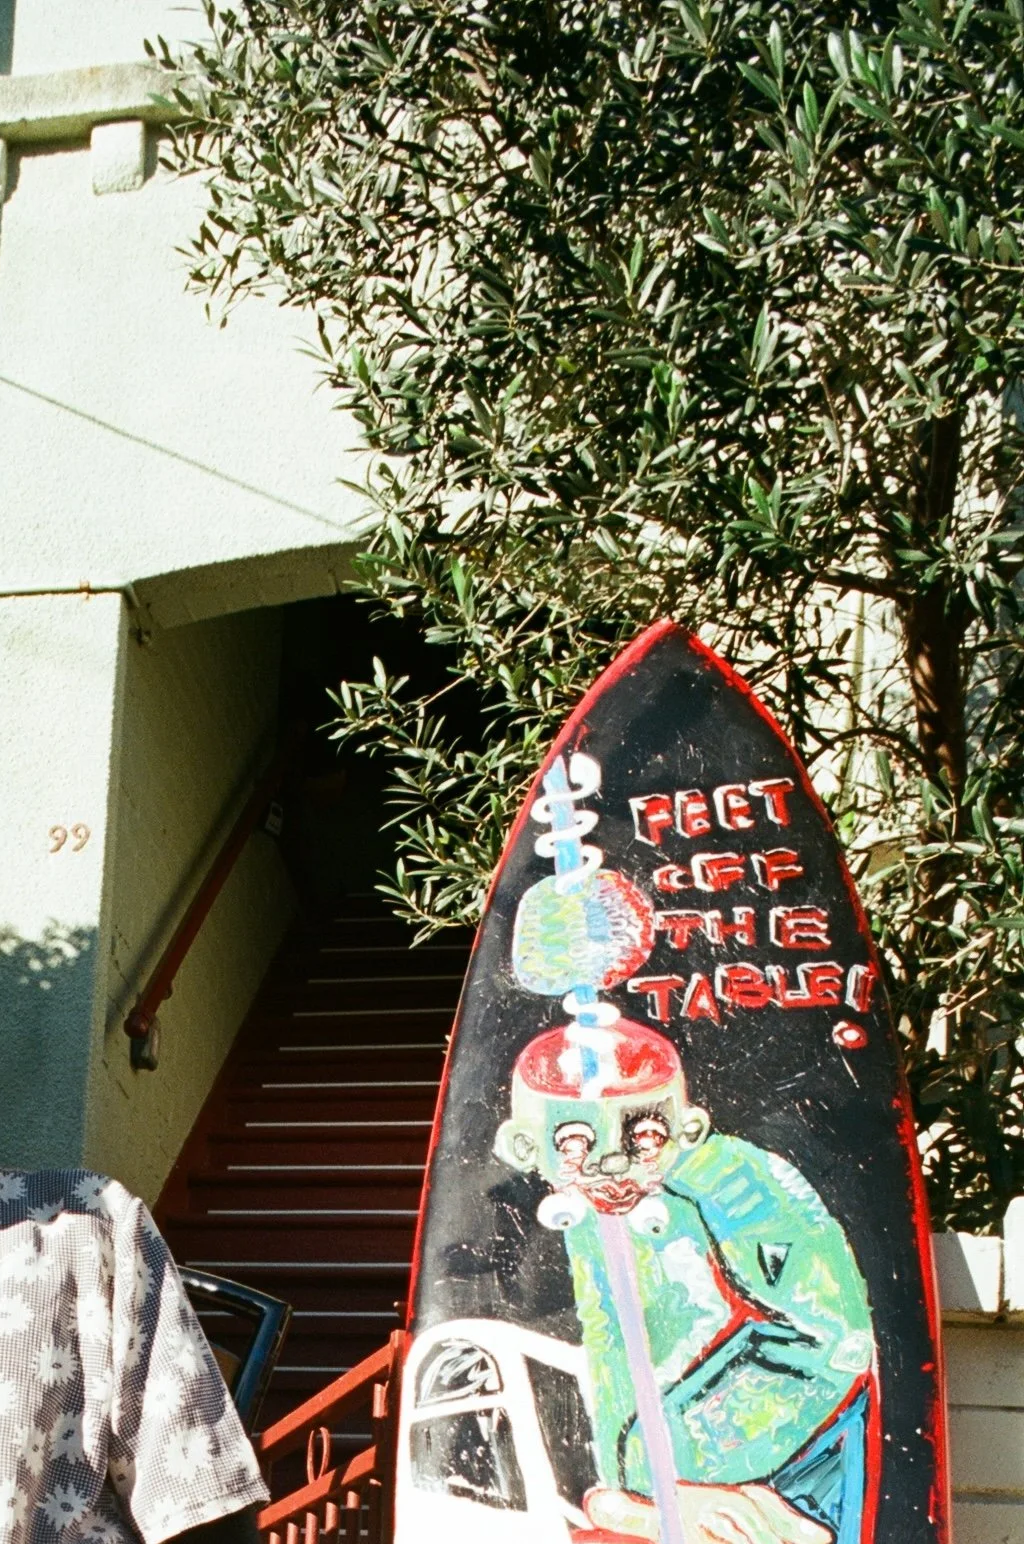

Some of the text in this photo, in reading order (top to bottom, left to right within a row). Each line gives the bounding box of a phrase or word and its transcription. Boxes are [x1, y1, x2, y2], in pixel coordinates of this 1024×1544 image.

[629, 777, 795, 847] FEET
[48, 822, 91, 853] 99
[653, 847, 804, 893] OFF
[654, 905, 832, 950] THE
[627, 960, 878, 1049] TABLE!
